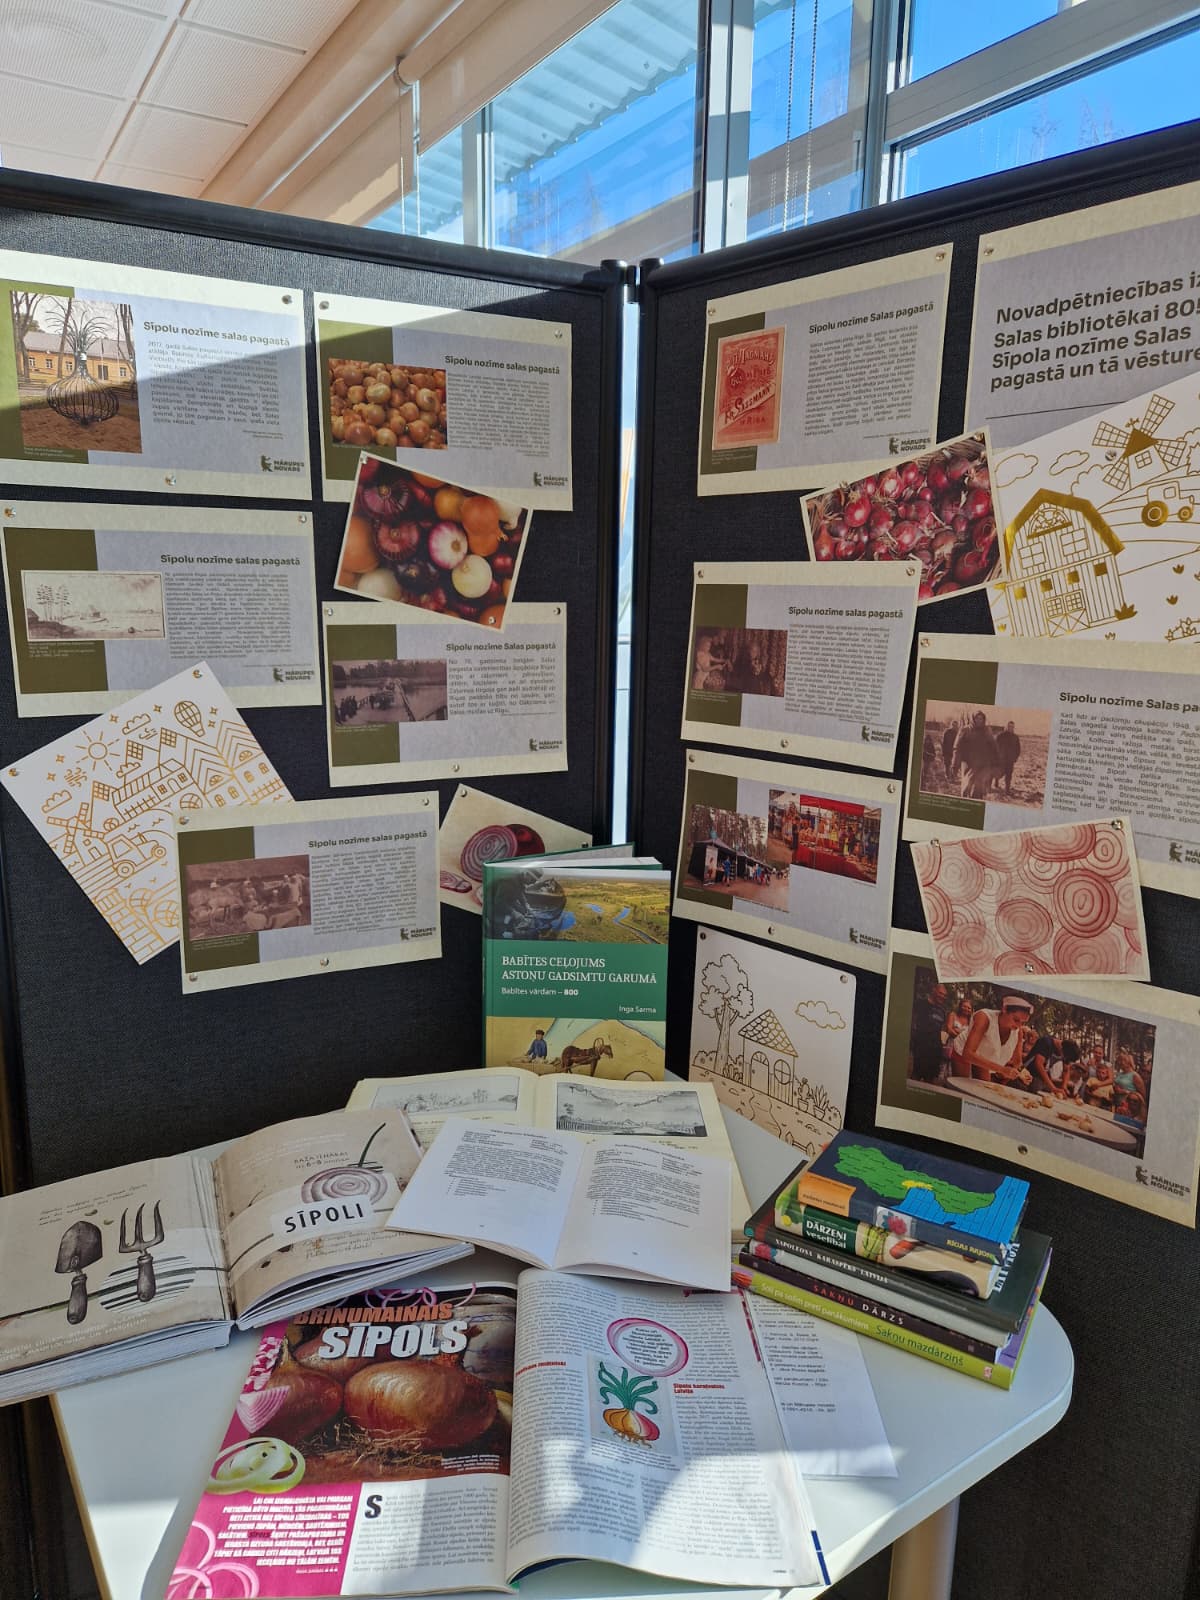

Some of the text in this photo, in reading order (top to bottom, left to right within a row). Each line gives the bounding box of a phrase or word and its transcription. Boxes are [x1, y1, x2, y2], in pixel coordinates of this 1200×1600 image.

[996, 277, 1183, 324] Novadpētniecības
[809, 302, 934, 334] Sīpolu nozīme Salas pagastā
[994, 328, 1042, 348] Salas
[1047, 304, 1159, 339] bibliotēkai
[143, 321, 290, 346] Sīpolu nozīme salas pagastā
[992, 326, 1191, 370] Sīpola nozīme Salas
[445, 356, 473, 366] Sīpolu
[474, 360, 504, 369] nozīme
[528, 366, 560, 375] pagastā
[991, 366, 1064, 392] pagastā
[1070, 362, 1094, 378] un
[1099, 355, 1118, 374] tā
[160, 555, 300, 566] Sīpolu nozīme salas pagastā
[788, 607, 814, 616] Sīpolu
[815, 608, 844, 616] nozīme
[868, 609, 903, 619] pagastā
[446, 643, 472, 652] Sīpolu
[526, 643, 556, 651] pagastā
[1060, 692, 1096, 704] Sīpolu
[1100, 696, 1144, 708] nozīme
[1146, 699, 1180, 711] Salas
[309, 840, 336, 849] Sīpolu
[394, 830, 427, 840] pagastā
[502, 955, 605, 969] BABĪTES CEĻOJUMS
[501, 970, 656, 984] ASTOŅU GADSIMTU GARUMĀ
[501, 986, 528, 996] Babītes
[529, 988, 556, 996] vārdam
[619, 1005, 634, 1014] Inga
[1150, 1181, 1184, 1196] NOVADS
[1151, 1175, 1191, 1193] MĀRUPES
[284, 1203, 364, 1233] SĪPOLI
[806, 1220, 847, 1241] DĀRZEŅI
[775, 1238, 813, 1257] NAPOLEONA
[813, 1285, 904, 1325] SAKŅU DĀRZS
[318, 1320, 468, 1359] SĪPOLS
[876, 1324, 964, 1366] Sakņu mazdārziņš
[365, 1495, 383, 1518] S
